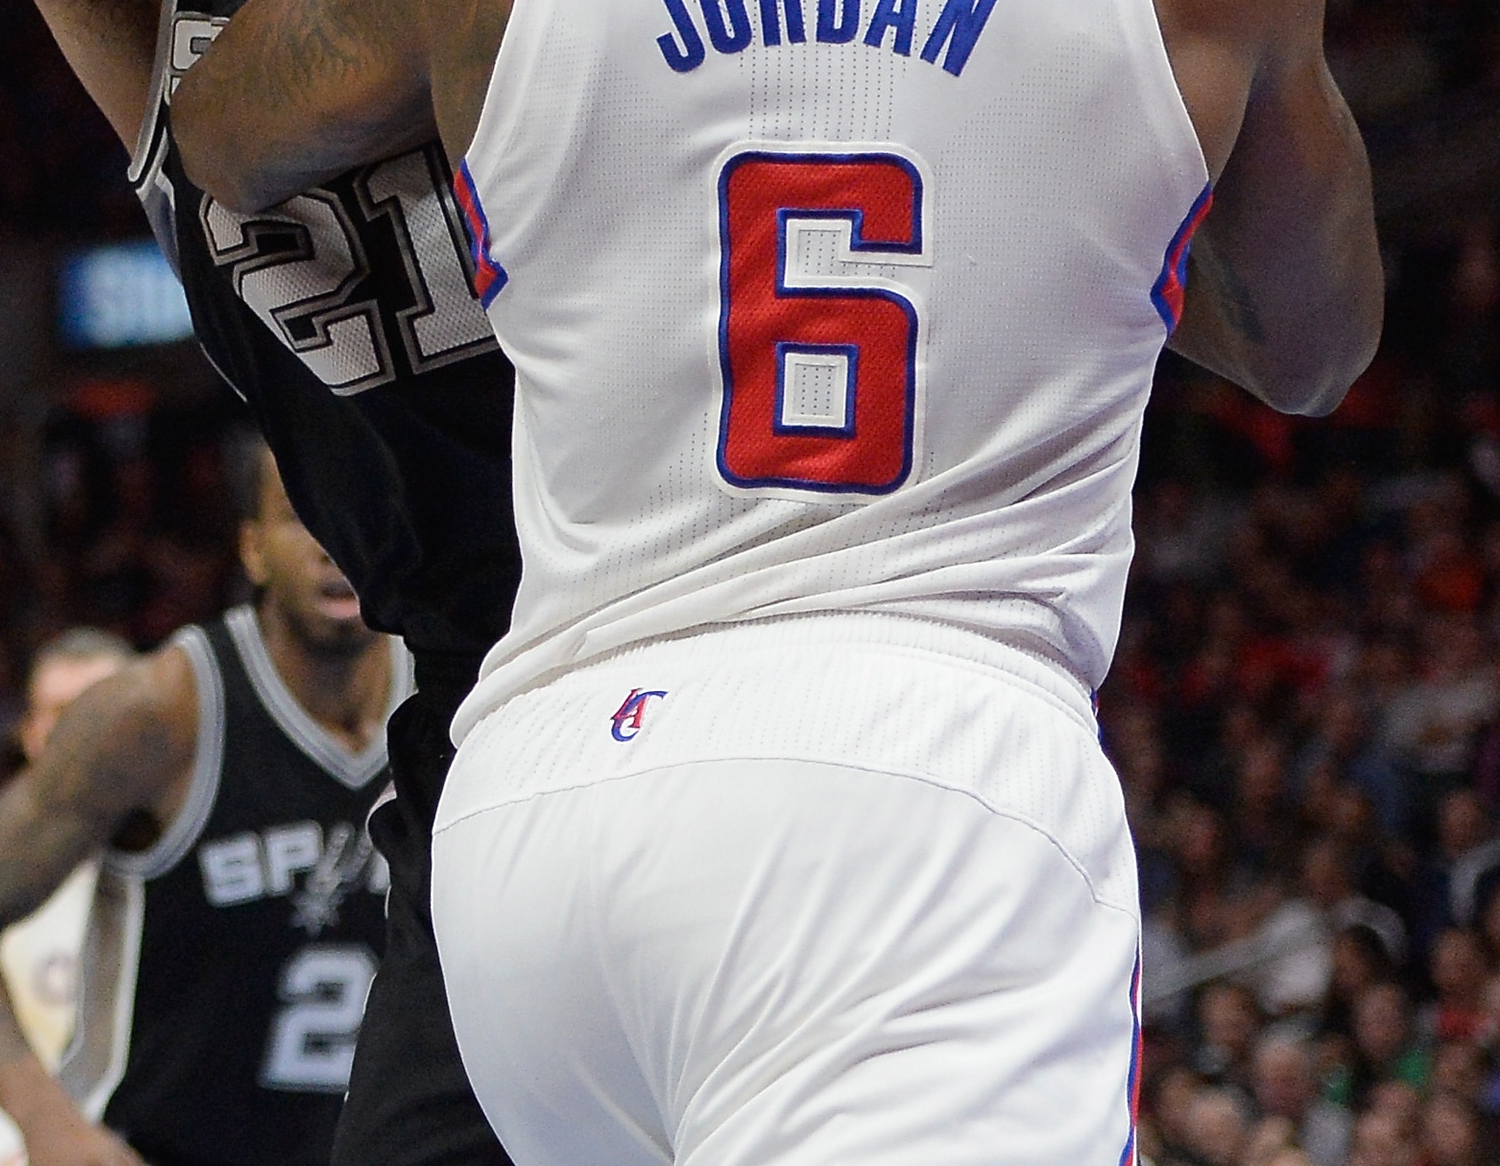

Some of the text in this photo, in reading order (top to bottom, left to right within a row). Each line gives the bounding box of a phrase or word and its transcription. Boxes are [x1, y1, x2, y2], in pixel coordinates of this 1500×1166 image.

[199, 144, 501, 396] 21
[711, 142, 932, 502] 6
[260, 944, 378, 1092] 2
